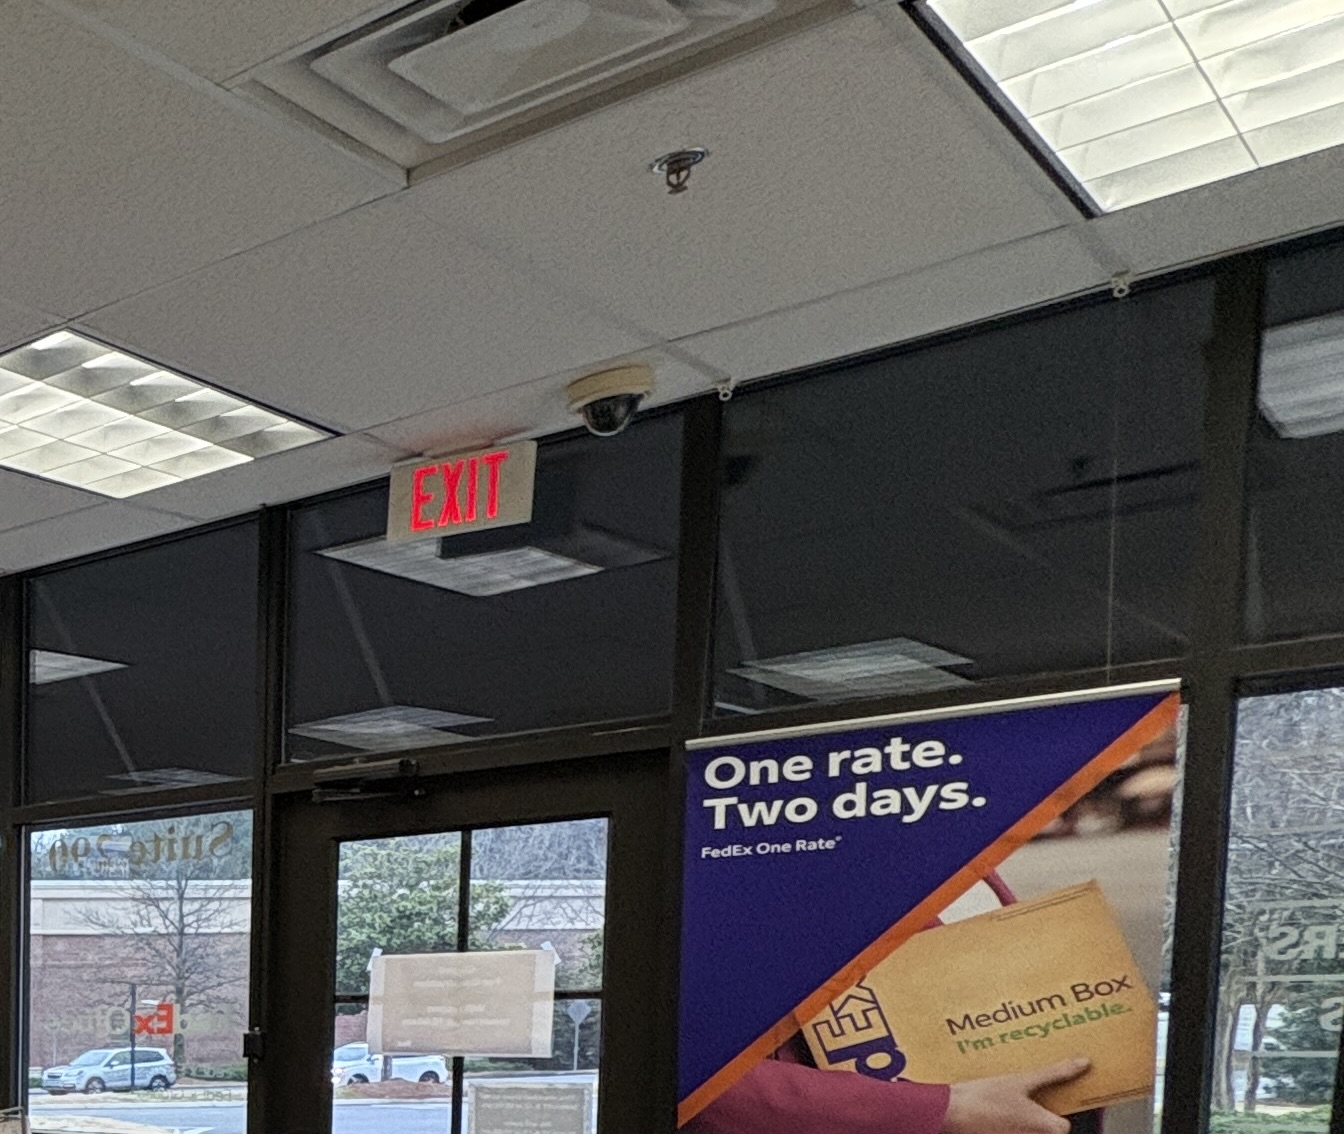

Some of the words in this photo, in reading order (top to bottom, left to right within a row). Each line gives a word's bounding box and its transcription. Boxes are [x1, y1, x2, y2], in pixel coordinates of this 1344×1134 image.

[408, 450, 509, 532] EXIT
[703, 754, 814, 791] One
[827, 736, 964, 778] rate.
[702, 796, 818, 831] Two
[832, 778, 987, 825] days.
[701, 844, 753, 859] FedEx
[756, 841, 792, 855] One
[945, 990, 1068, 1036] Medium
[1070, 974, 1133, 1008] Box
[956, 1032, 995, 1056] I'm
[998, 1002, 1134, 1046] recyclable.
